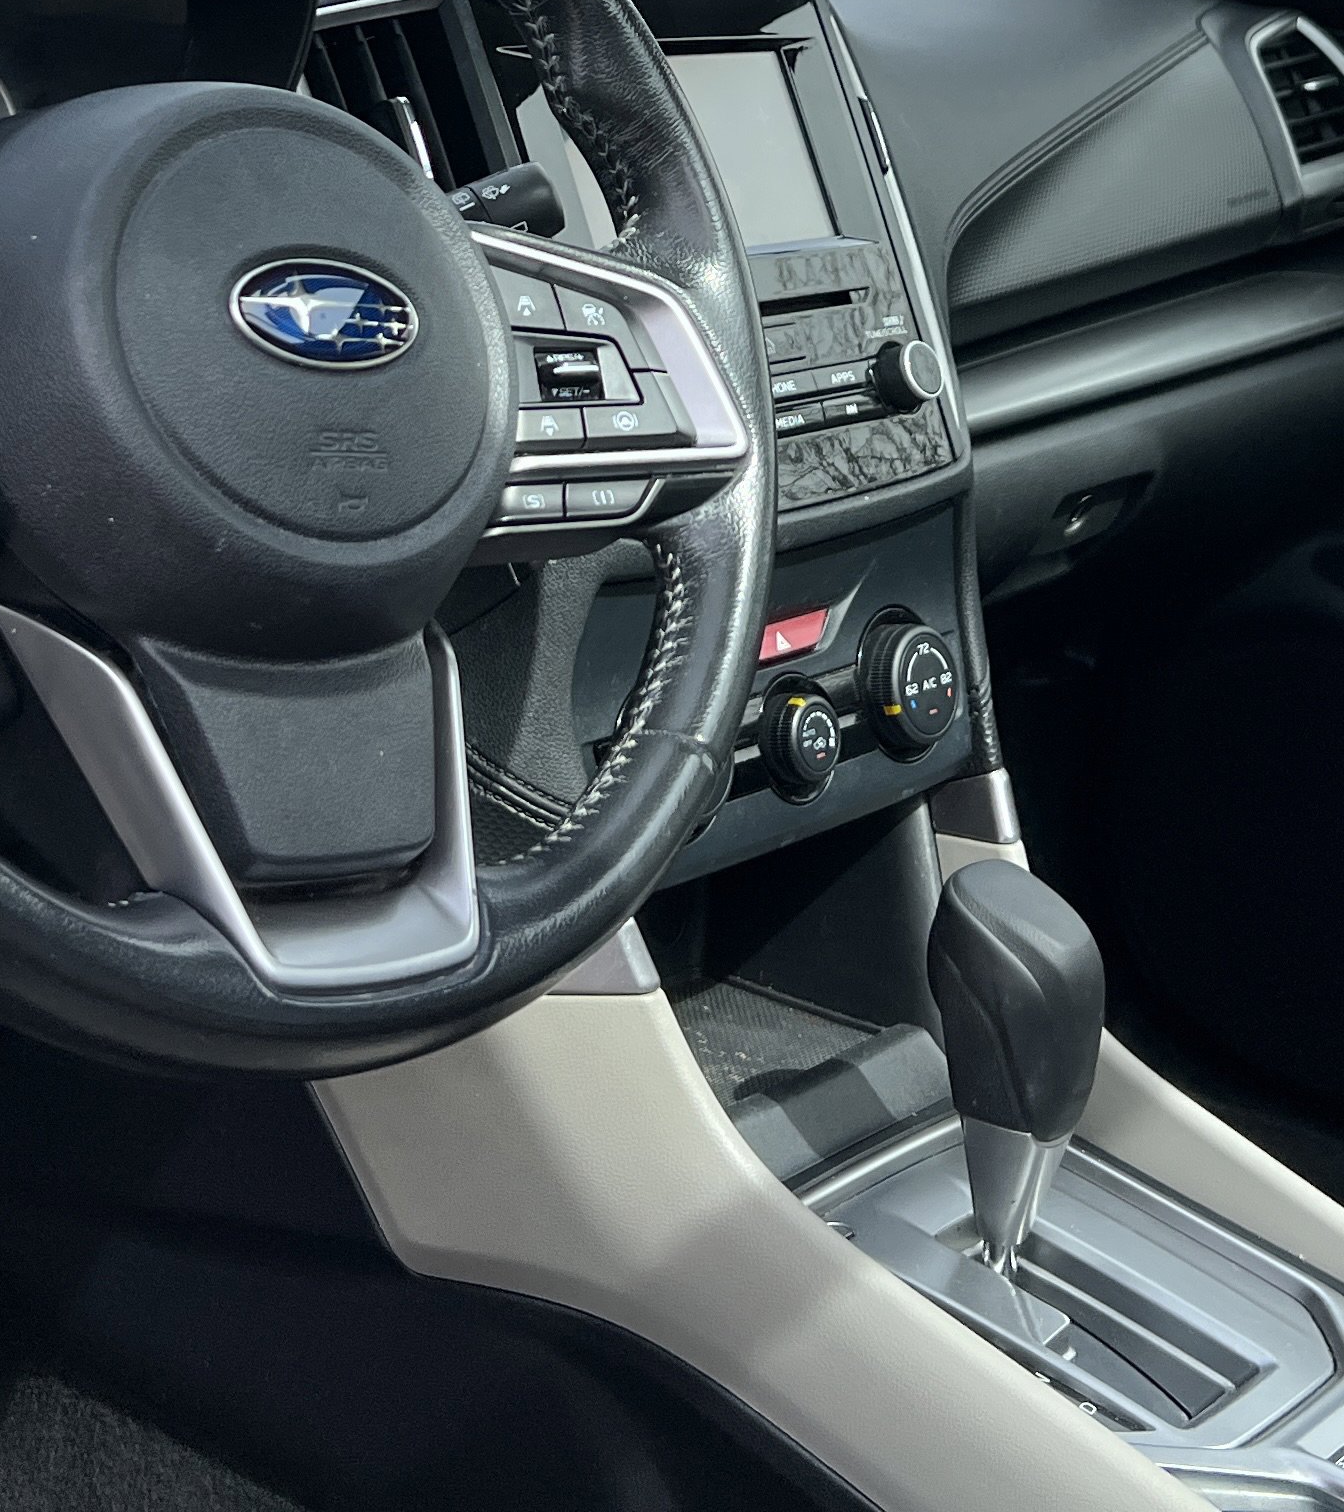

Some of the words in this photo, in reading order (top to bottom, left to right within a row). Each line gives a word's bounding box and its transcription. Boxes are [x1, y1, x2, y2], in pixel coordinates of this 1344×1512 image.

[831, 370, 856, 385] APPS
[775, 414, 805, 430] MEDIA
[917, 642, 930, 655] 72
[940, 671, 953, 685] 82
[905, 682, 919, 697] 62
[1079, 1401, 1097, 1415] D
